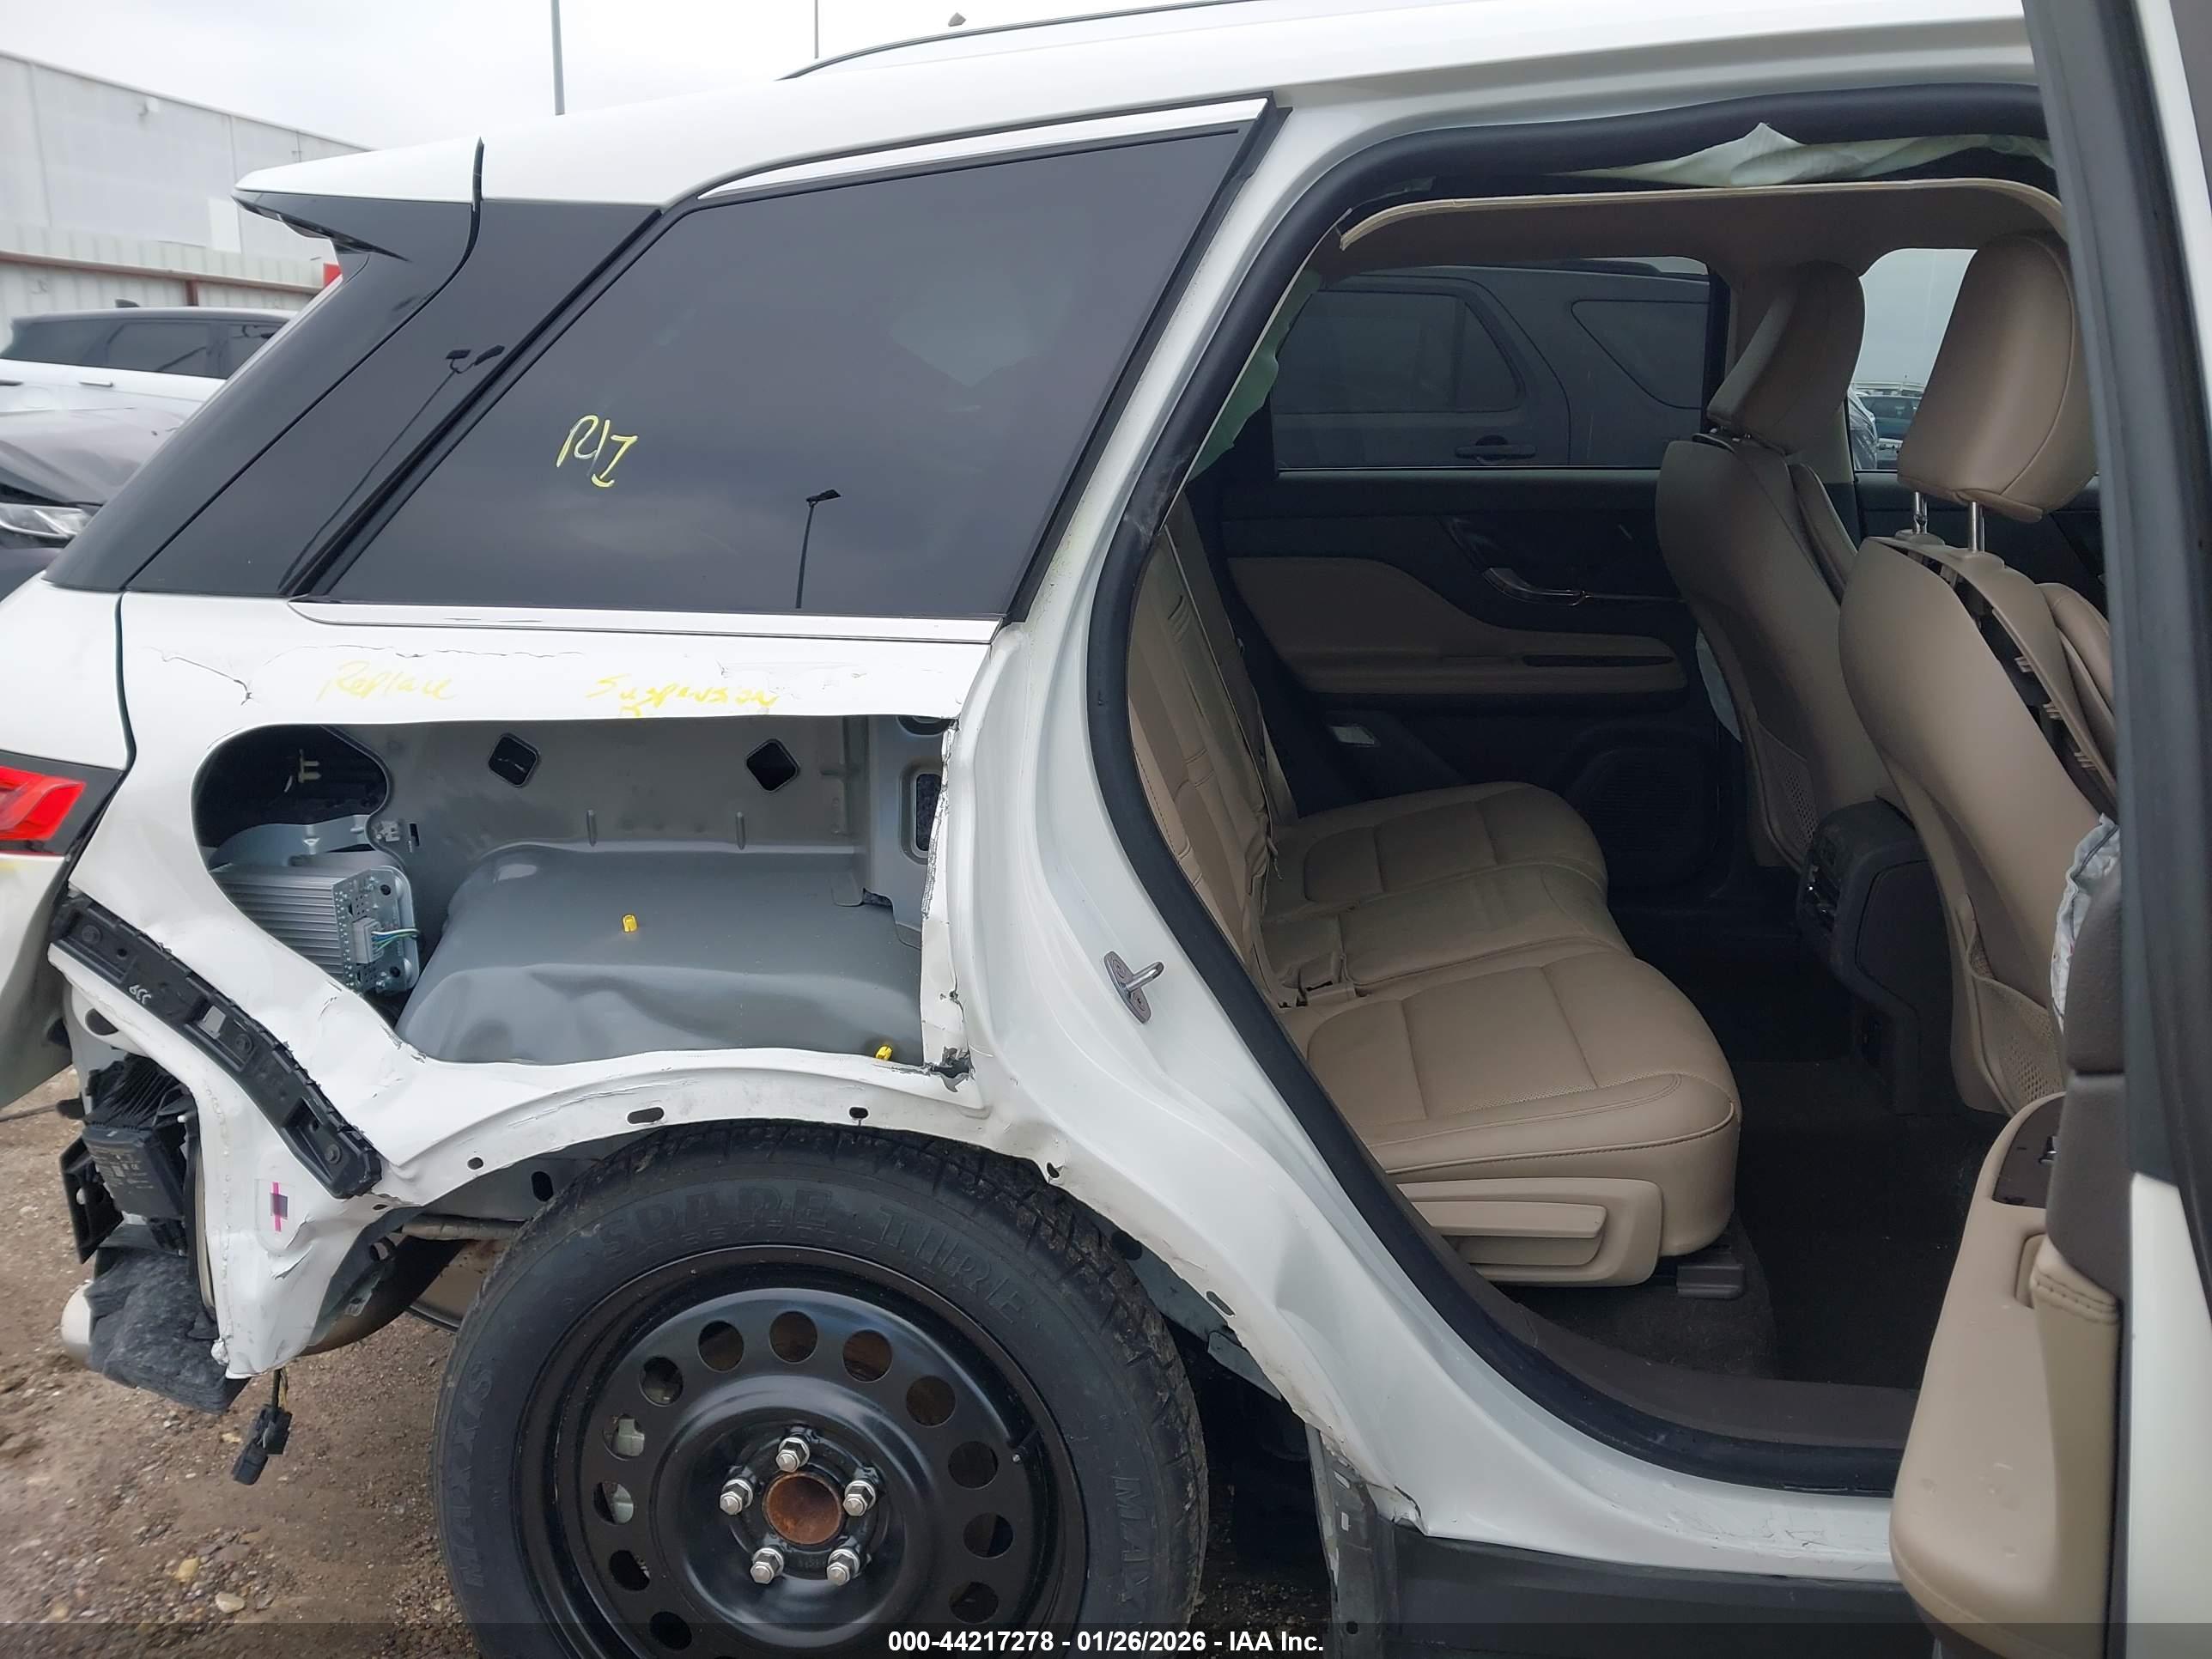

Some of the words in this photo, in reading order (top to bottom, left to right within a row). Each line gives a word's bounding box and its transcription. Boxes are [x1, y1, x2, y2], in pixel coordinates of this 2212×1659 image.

[597, 1184, 836, 1261] SPARE
[878, 1203, 1026, 1326] TIRE
[449, 1359, 495, 1588] MAXXIS
